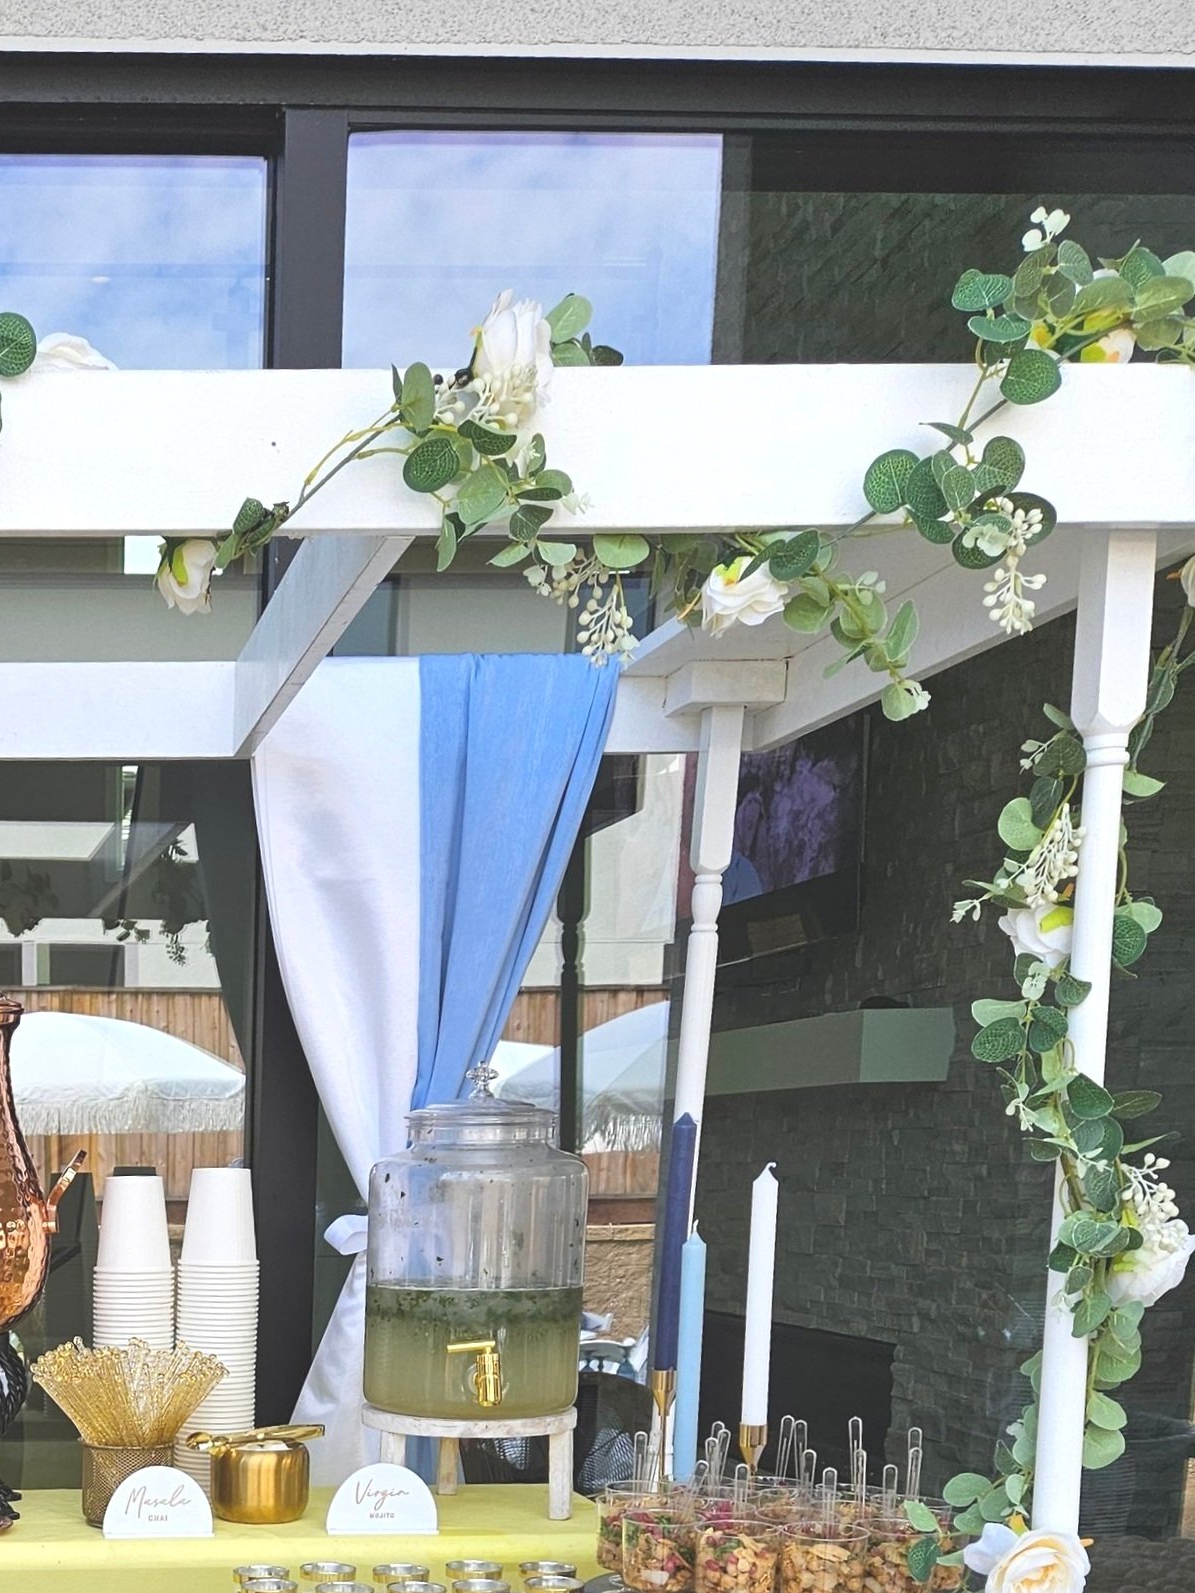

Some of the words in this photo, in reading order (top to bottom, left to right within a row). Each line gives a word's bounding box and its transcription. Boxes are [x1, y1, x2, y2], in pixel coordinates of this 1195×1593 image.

[124, 1484, 192, 1519] Masala
[355, 1478, 410, 1511] Virgin
[148, 1514, 168, 1522] CHAI
